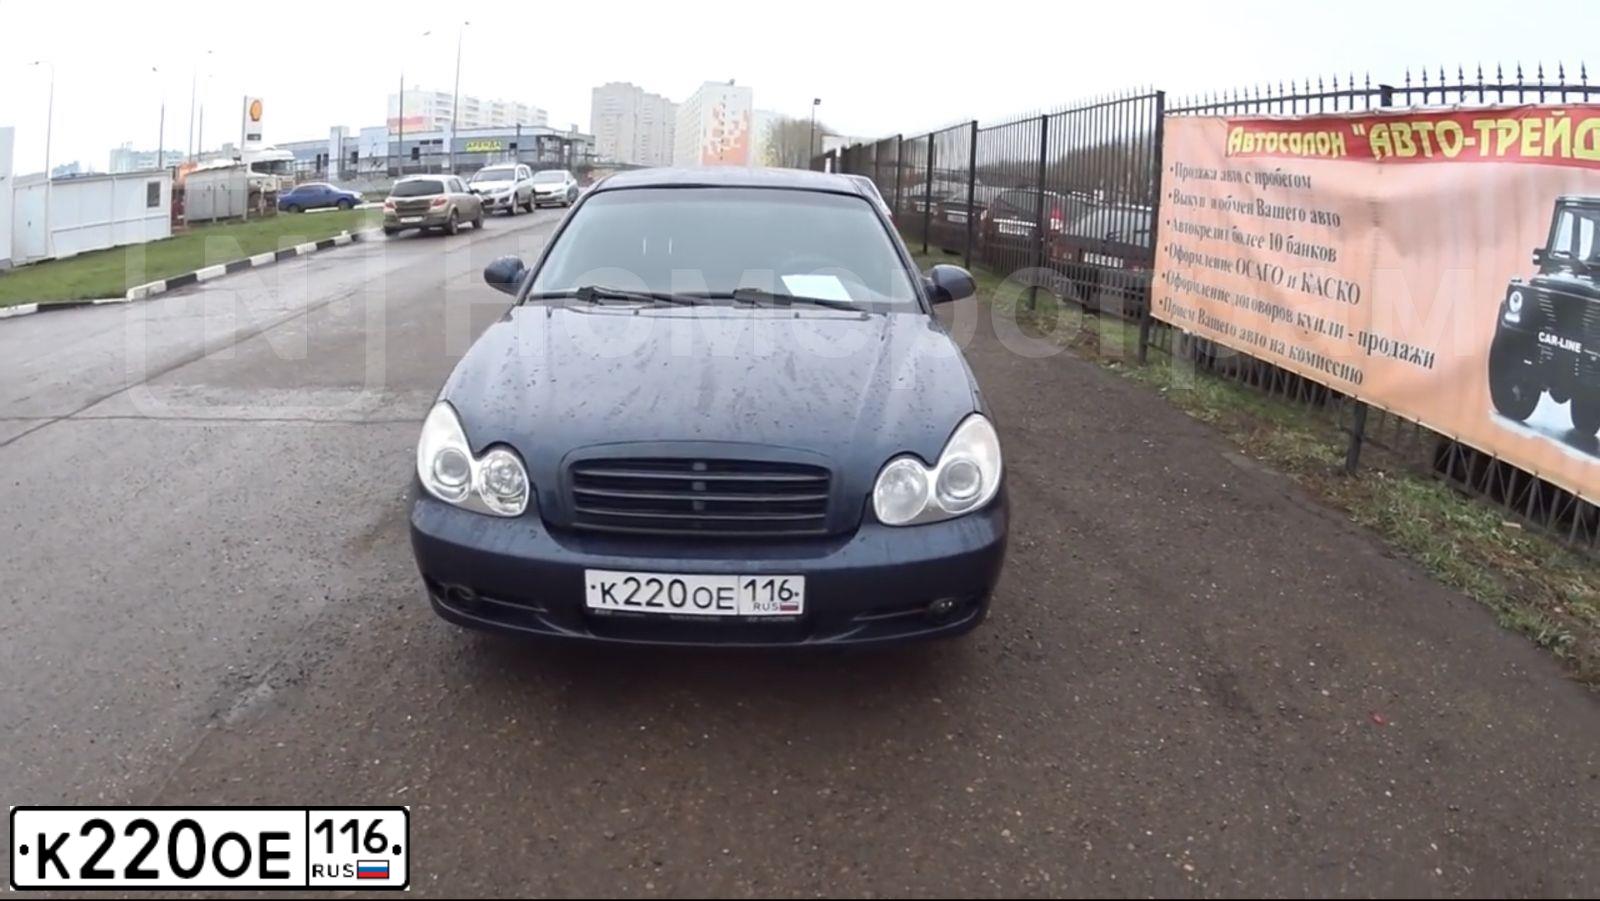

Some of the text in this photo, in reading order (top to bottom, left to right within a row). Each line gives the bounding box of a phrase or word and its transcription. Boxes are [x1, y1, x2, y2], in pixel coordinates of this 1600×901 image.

[1174, 161, 1311, 190] Продажа авто с пробегом
[1173, 189, 1206, 211] Выкуп
[1256, 198, 1306, 221] Вашего
[1310, 210, 1341, 228] авто
[1172, 217, 1337, 263] Автокредит более 10 банков
[1169, 242, 1361, 306] Оформление ОСАГО и КАСКО
[1166, 270, 1231, 304] Оформление
[1232, 292, 1294, 324] договоров
[1297, 311, 1345, 339] купли
[1358, 330, 1436, 370] продажи
[1198, 307, 1237, 337] Вашего
[1239, 327, 1267, 349] авто
[1270, 337, 1285, 355] на
[1288, 345, 1364, 387] комиссию
[1538, 331, 1582, 354] CAR-LINE
[743, 578, 794, 603] 116
[753, 602, 779, 612] RUS
